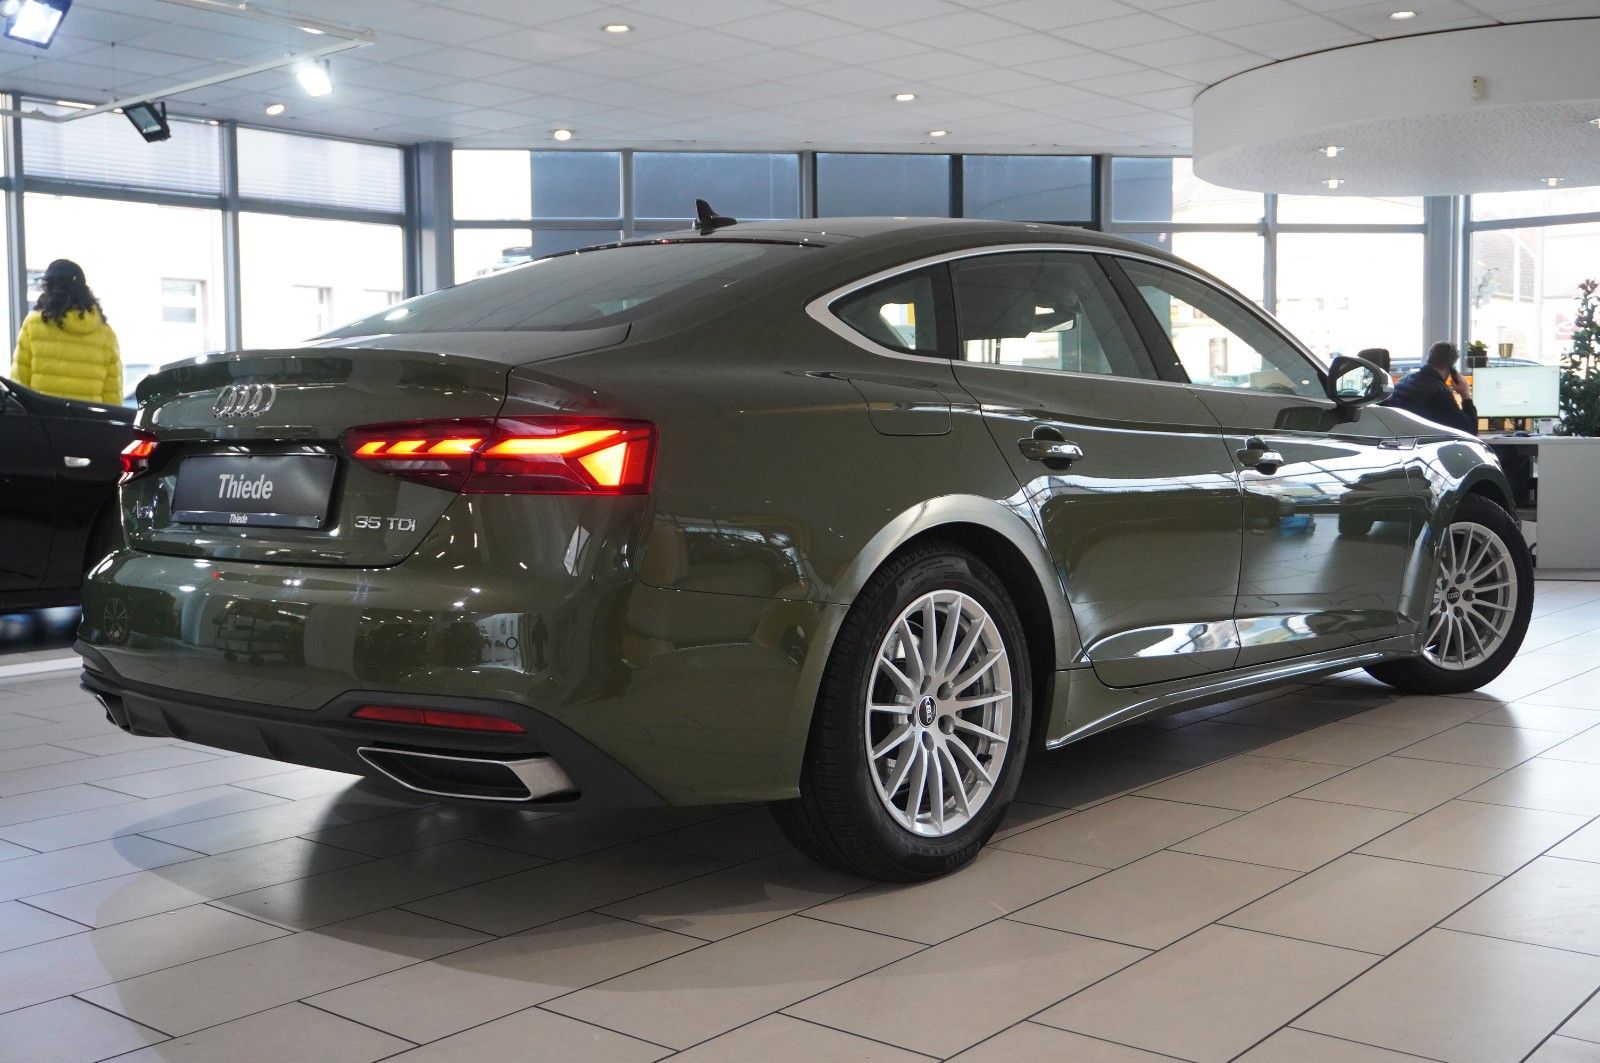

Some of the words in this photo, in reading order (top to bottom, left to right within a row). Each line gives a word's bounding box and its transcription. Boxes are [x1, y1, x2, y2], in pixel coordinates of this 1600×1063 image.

[219, 474, 273, 499] Thiede
[229, 513, 248, 524] Thiede
[354, 515, 381, 529] 35
[386, 517, 416, 532] TDI
